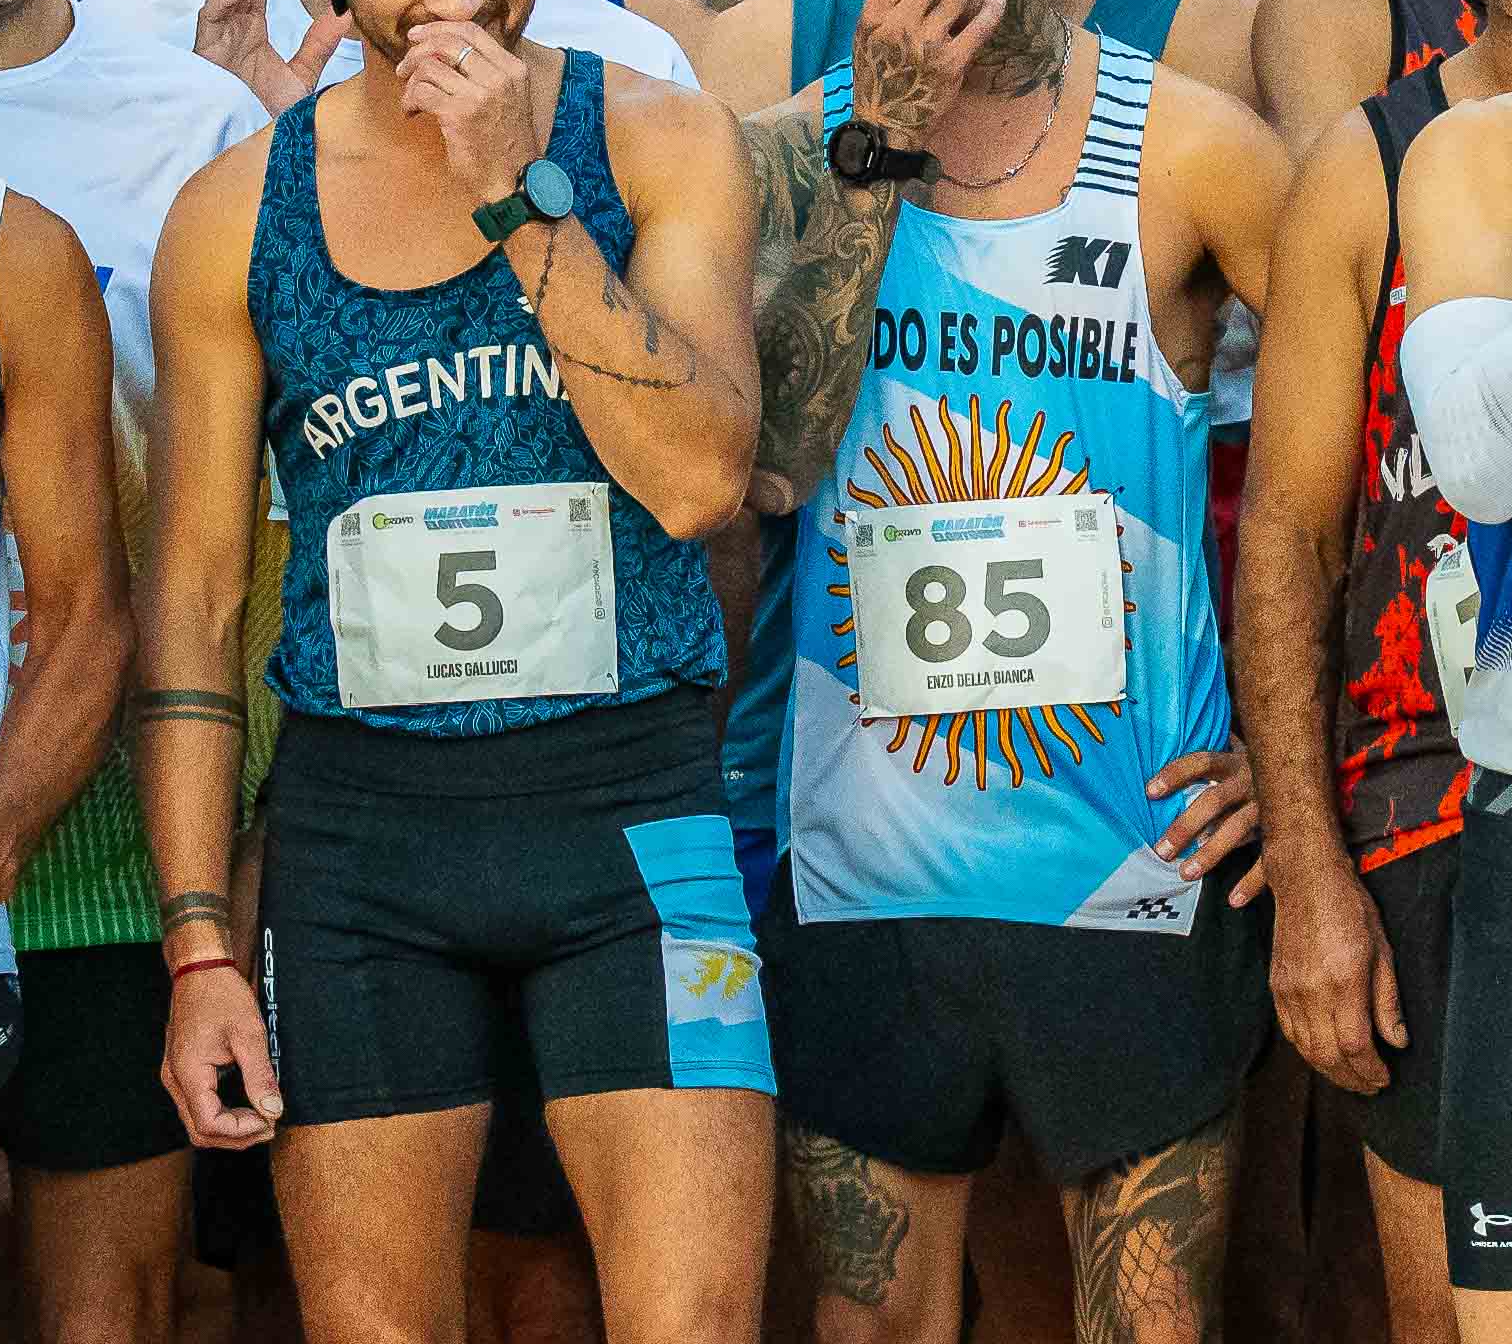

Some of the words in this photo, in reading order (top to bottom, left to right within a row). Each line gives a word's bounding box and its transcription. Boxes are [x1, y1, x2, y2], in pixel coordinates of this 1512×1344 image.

[940, 312, 979, 375] ES
[992, 313, 1138, 383] POSIBLE
[304, 344, 569, 459] ARGENTIN
[434, 550, 504, 651] 5
[906, 559, 1051, 663] 85
[427, 661, 462, 678] LUCAS
[464, 659, 518, 677] GALLUCCI
[927, 674, 954, 689] ENZO
[957, 672, 991, 687] DELLA
[994, 669, 1035, 684] BIANCA
